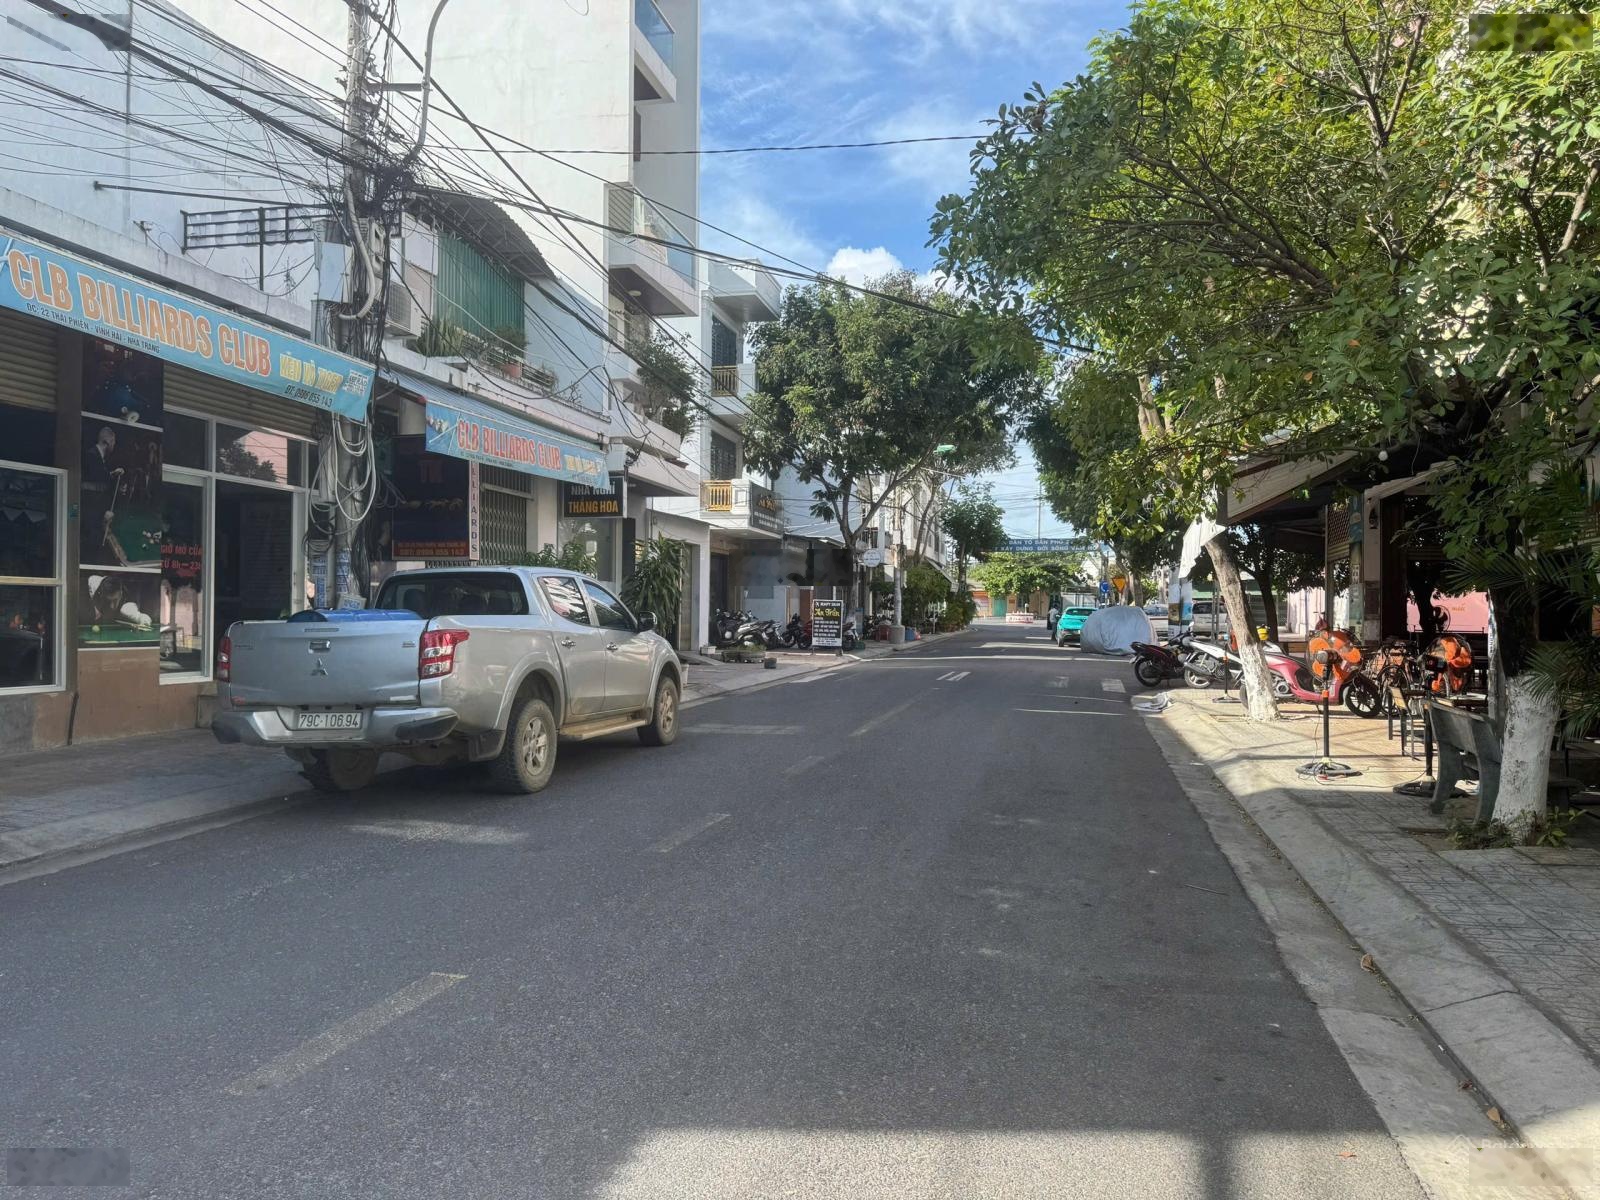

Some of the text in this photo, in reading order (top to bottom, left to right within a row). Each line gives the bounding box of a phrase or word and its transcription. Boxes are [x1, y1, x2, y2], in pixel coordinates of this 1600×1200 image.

[7, 249, 73, 312] CLB
[77, 272, 213, 358] BILLIARDS
[218, 323, 272, 377] CLUB
[457, 419, 480, 452] CLB
[483, 426, 536, 465] BILLIARDS
[538, 441, 562, 471] CLUB
